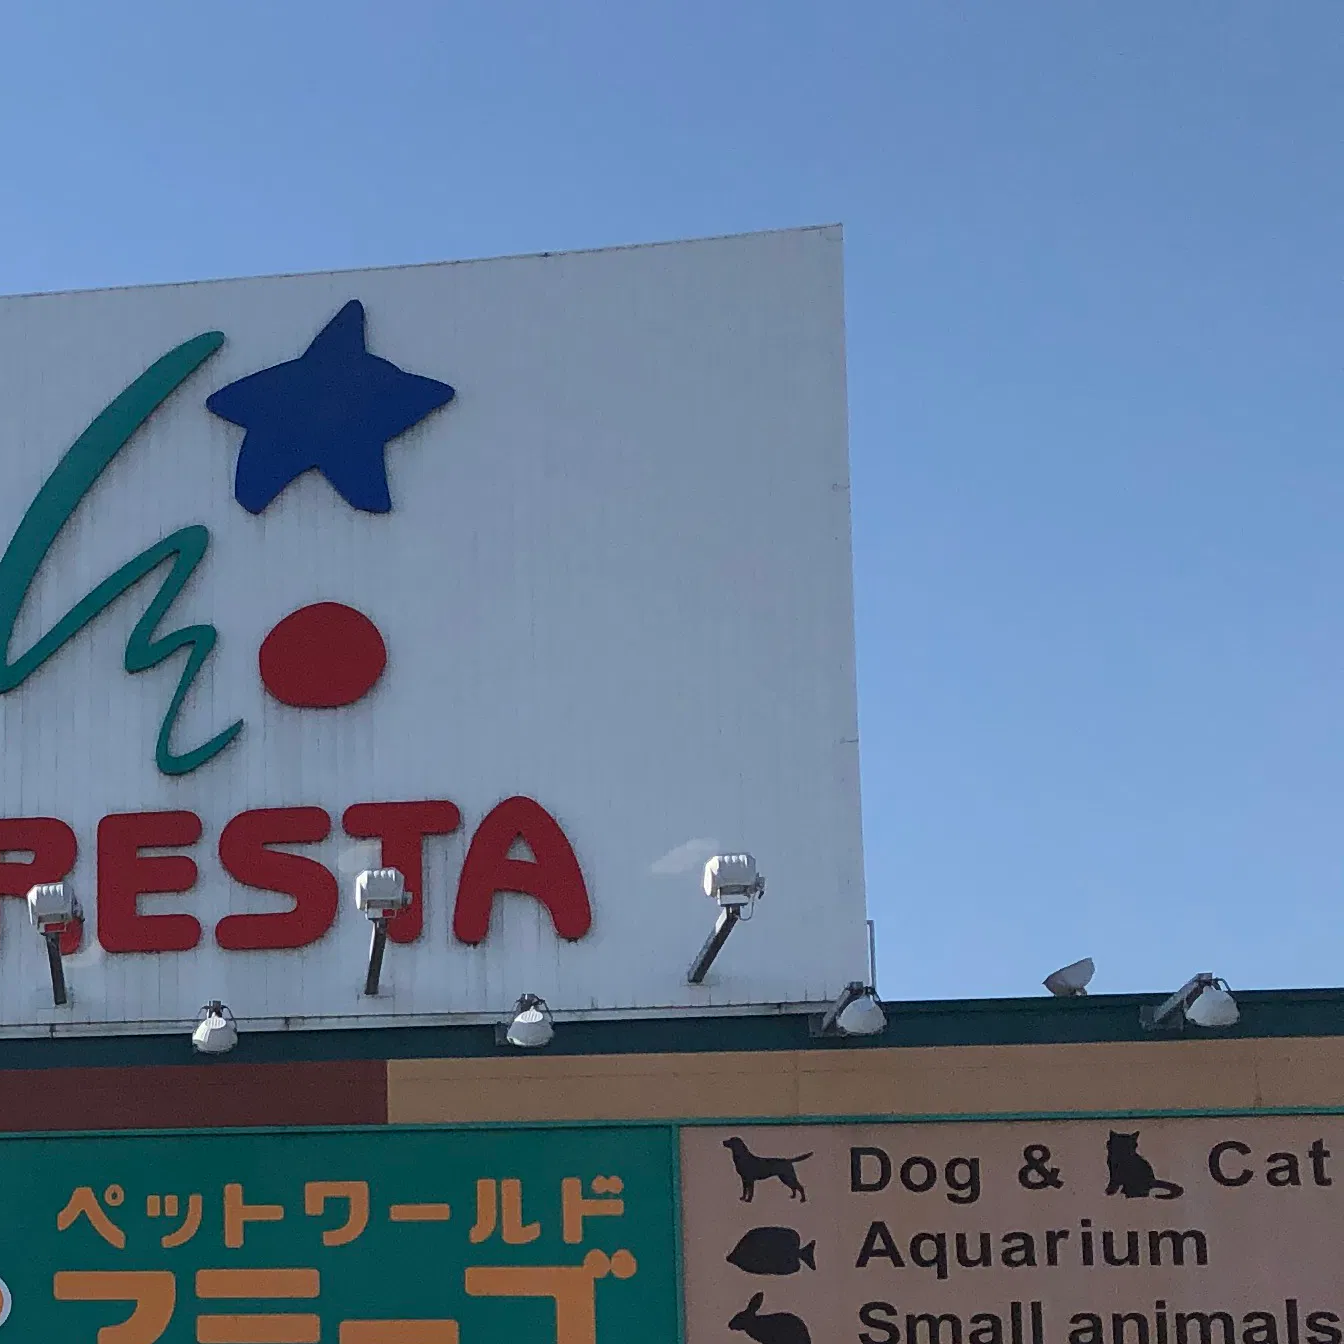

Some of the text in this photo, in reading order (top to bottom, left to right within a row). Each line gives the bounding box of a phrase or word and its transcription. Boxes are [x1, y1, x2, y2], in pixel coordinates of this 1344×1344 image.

[850, 1138, 1332, 1204] Dog & Cat
[57, 1176, 624, 1249] ペットワールド
[855, 1219, 1208, 1279] Aquarium
